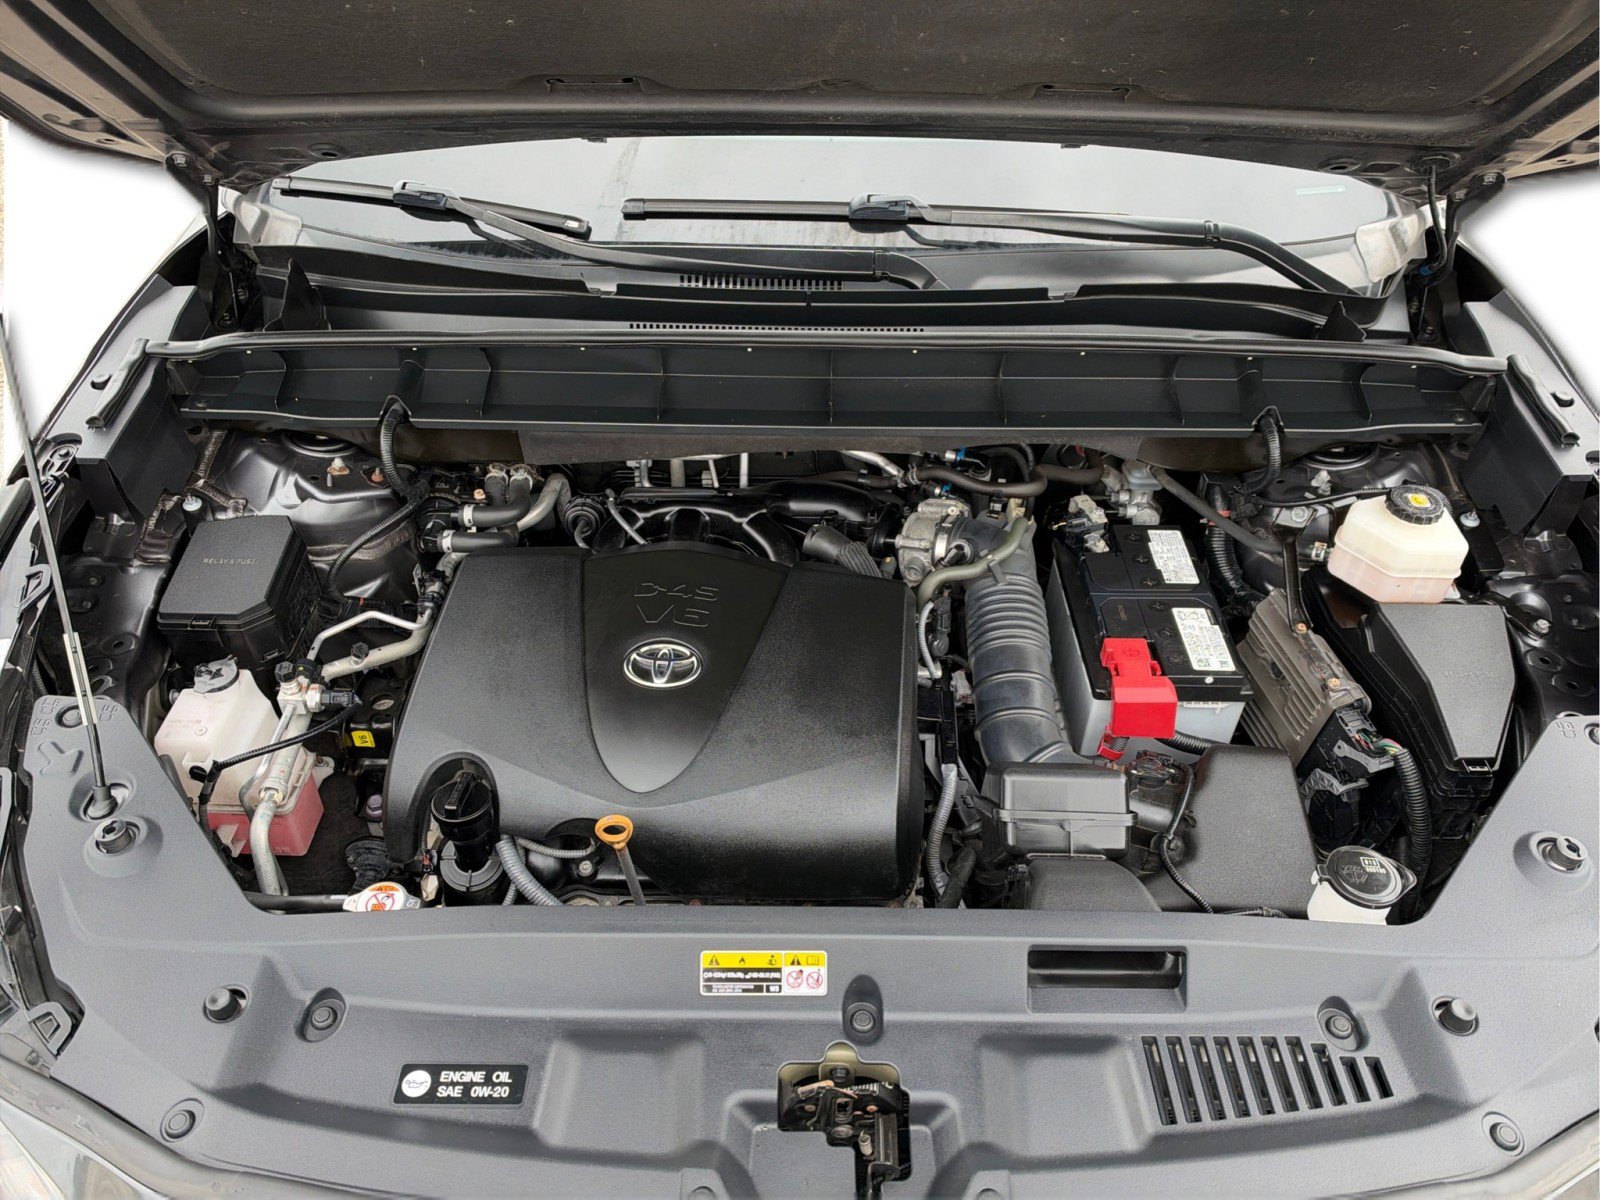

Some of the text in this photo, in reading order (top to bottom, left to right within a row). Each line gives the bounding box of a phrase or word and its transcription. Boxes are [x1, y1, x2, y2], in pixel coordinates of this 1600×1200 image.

[636, 604, 711, 628] V6
[439, 1071, 513, 1083] ENGINE OIL
[436, 1085, 510, 1098] SAE 0W-20
